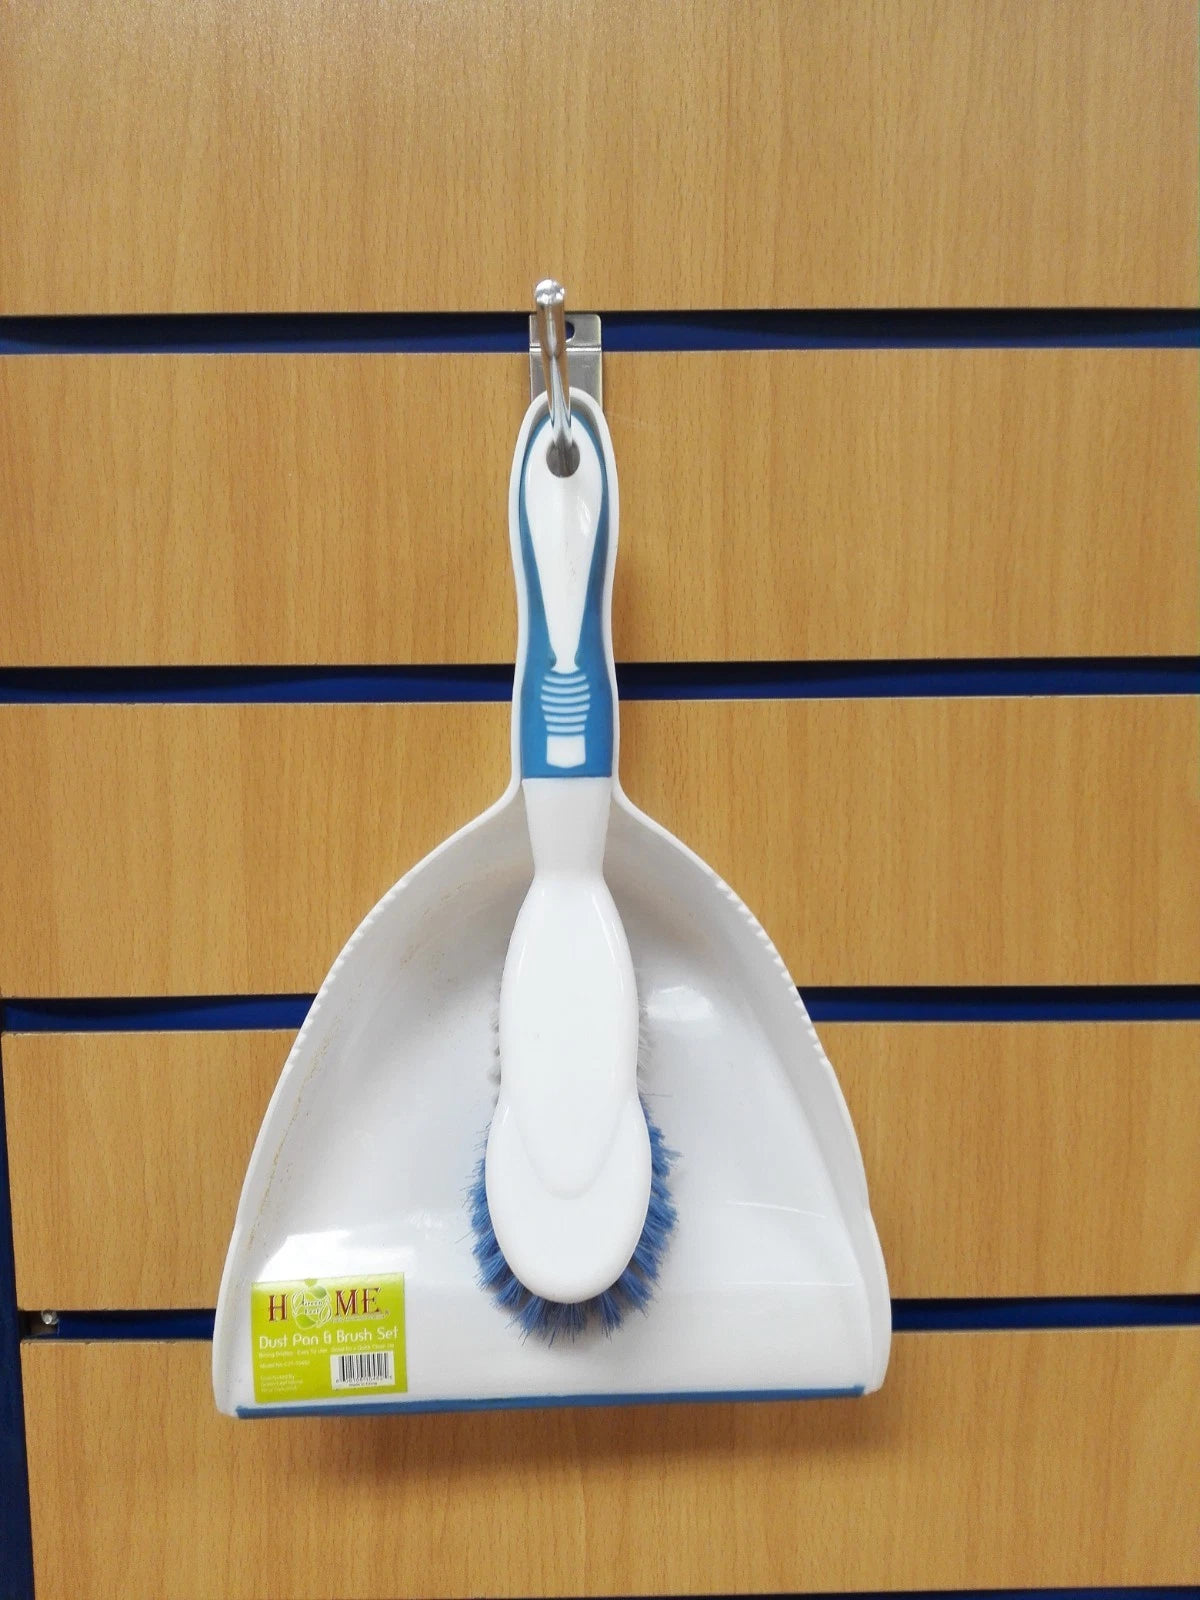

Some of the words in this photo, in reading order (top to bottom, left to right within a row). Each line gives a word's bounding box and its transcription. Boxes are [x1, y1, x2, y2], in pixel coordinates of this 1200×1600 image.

[259, 1334, 287, 1349] Dust
[292, 1333, 319, 1346] Pan
[323, 1331, 332, 1344] &
[336, 1328, 372, 1343] Brush
[376, 1326, 399, 1340] Set
